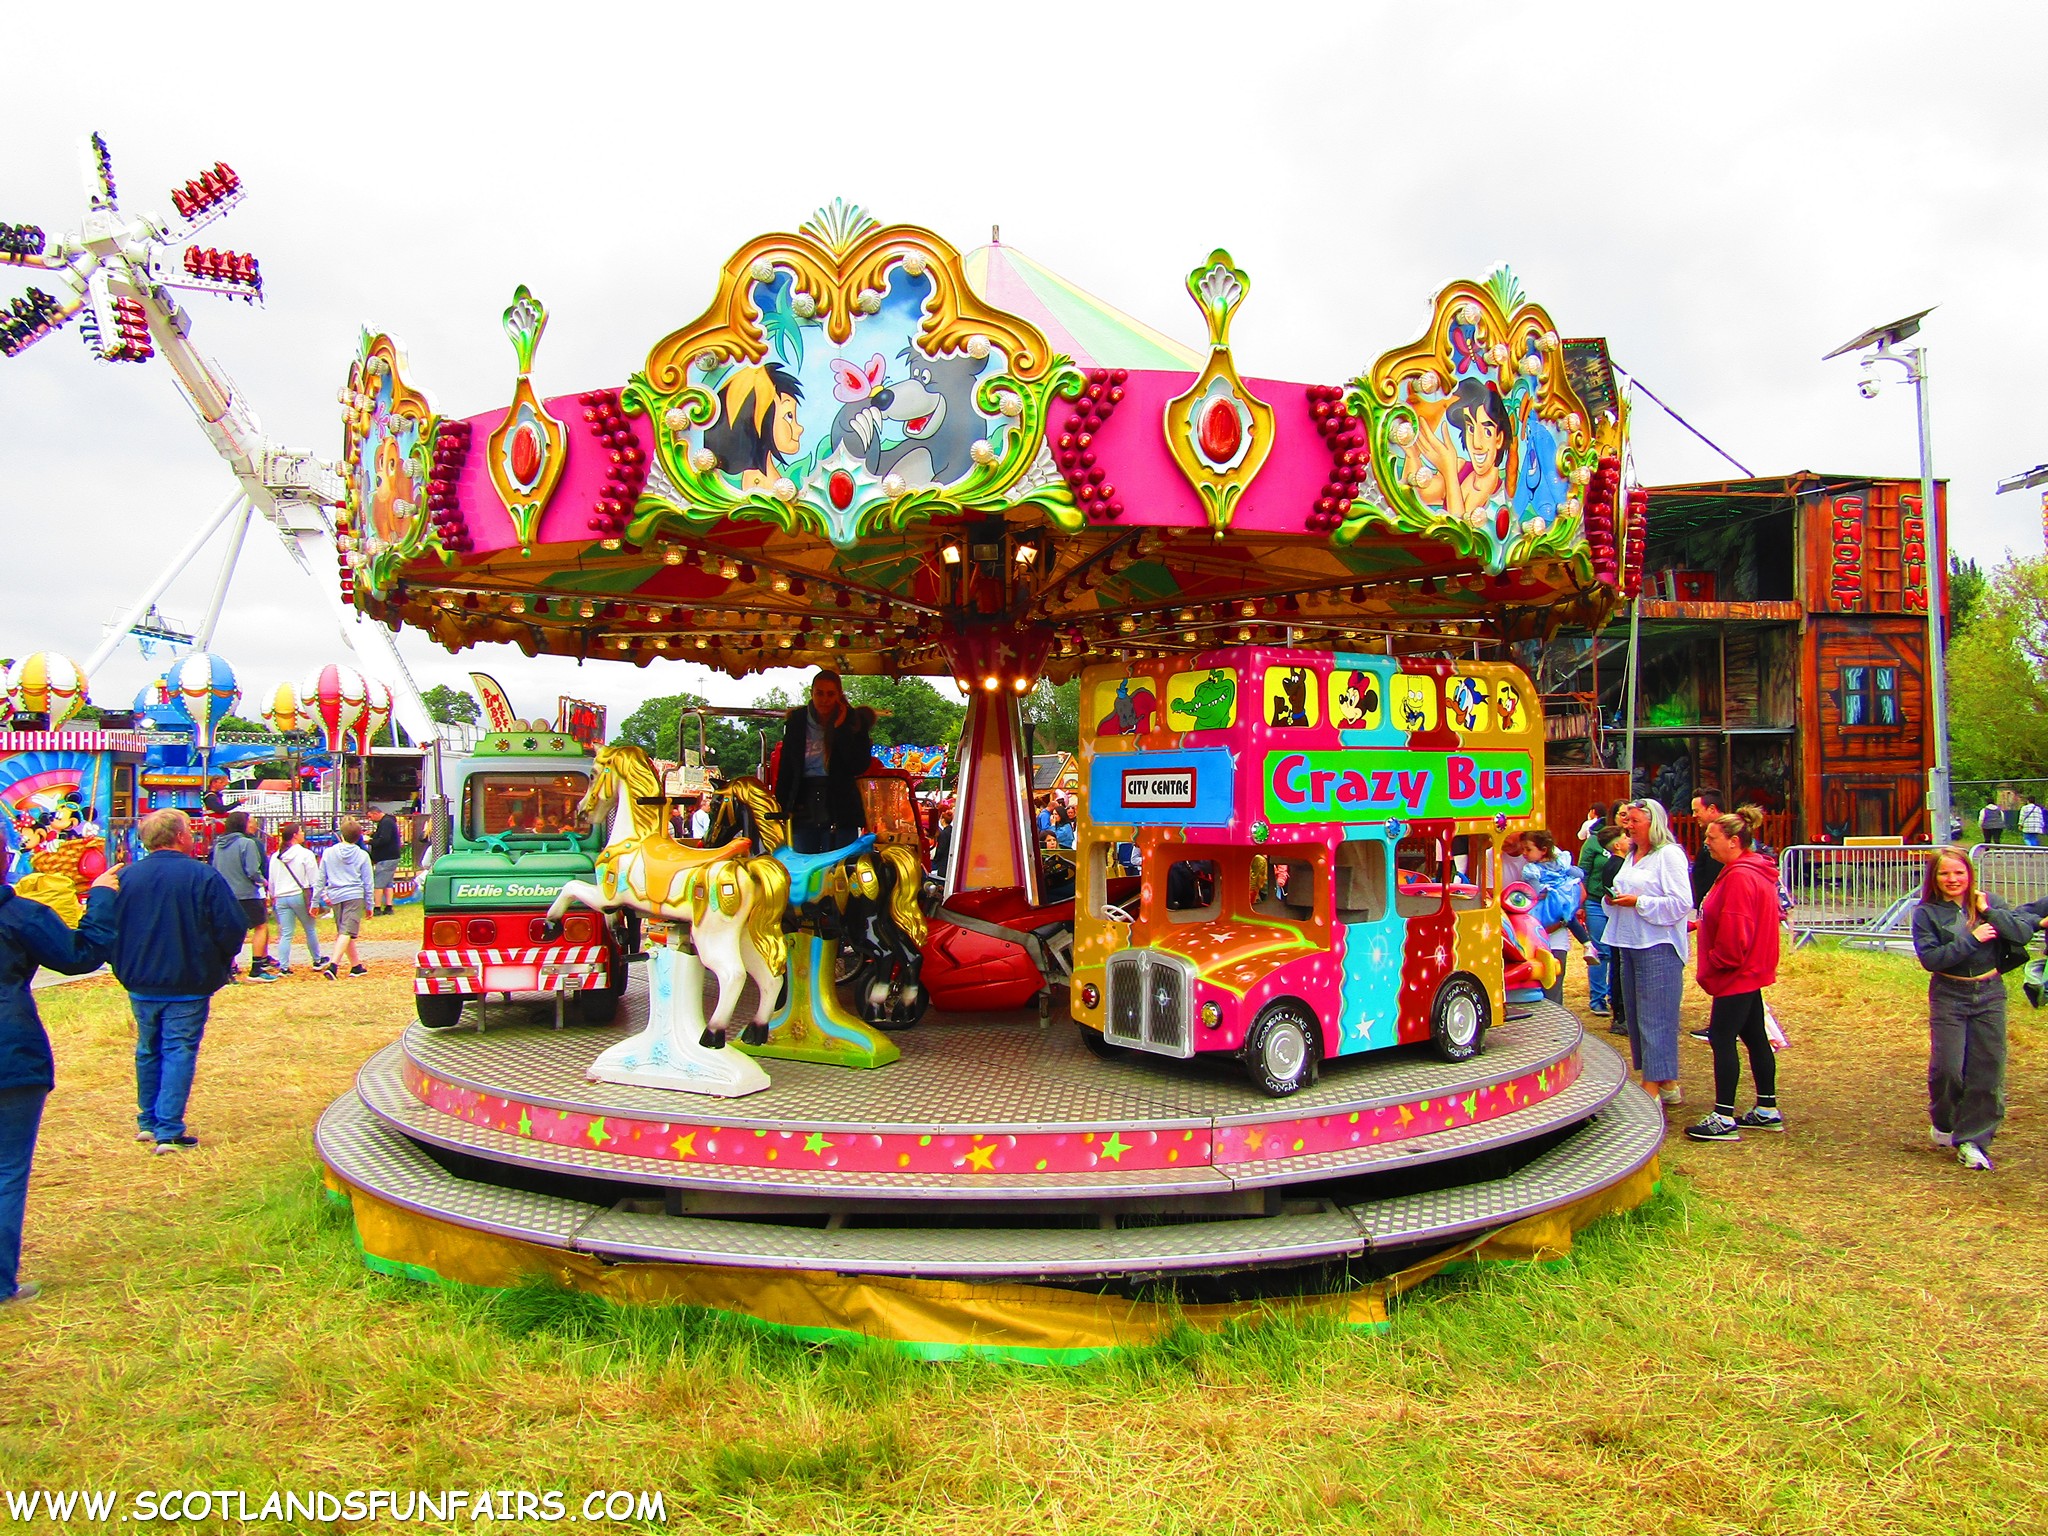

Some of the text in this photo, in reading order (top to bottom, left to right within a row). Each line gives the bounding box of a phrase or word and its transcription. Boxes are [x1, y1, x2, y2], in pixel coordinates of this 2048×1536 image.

[1832, 495, 1863, 613] GHOST
[1900, 494, 1929, 612] TRAIN
[1128, 779, 1189, 795] CITY CENTRE
[1272, 754, 1525, 811] Crazy Bus
[457, 883, 562, 897] Eddie Stobar
